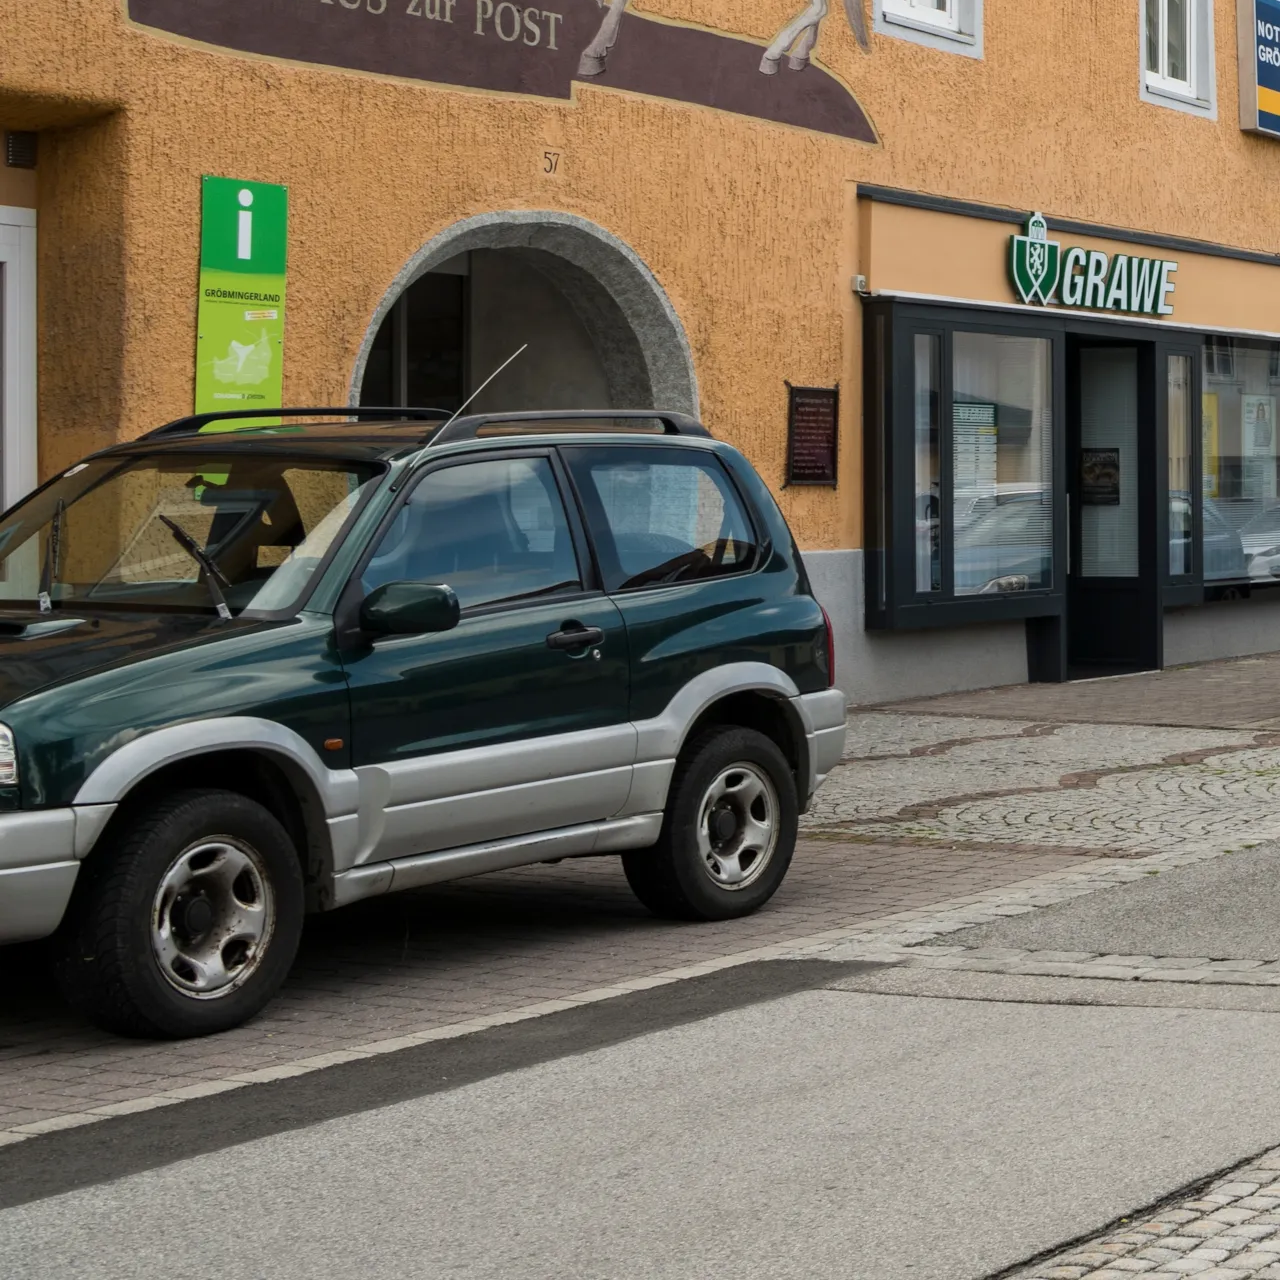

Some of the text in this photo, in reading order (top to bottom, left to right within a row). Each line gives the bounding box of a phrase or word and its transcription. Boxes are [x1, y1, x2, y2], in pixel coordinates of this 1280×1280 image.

[543, 151, 561, 174] 57
[1060, 246, 1179, 315] GRAWE
[204, 288, 281, 303] GRÖBMINGERLAND
